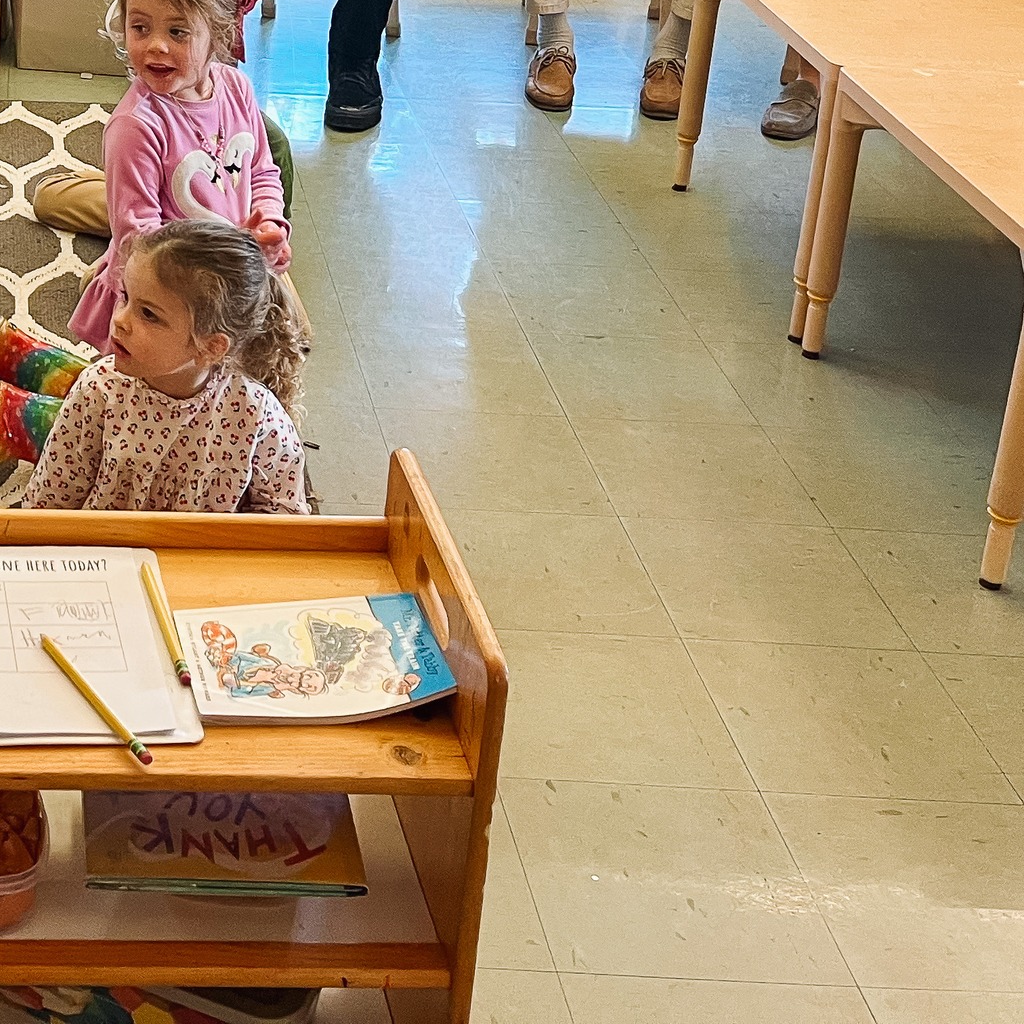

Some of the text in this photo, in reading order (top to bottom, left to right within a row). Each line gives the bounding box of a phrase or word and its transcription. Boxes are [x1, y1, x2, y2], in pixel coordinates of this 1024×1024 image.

[26, 559, 57, 572] HERE
[61, 559, 108, 572] TODAY?
[131, 813, 327, 866] THANK
